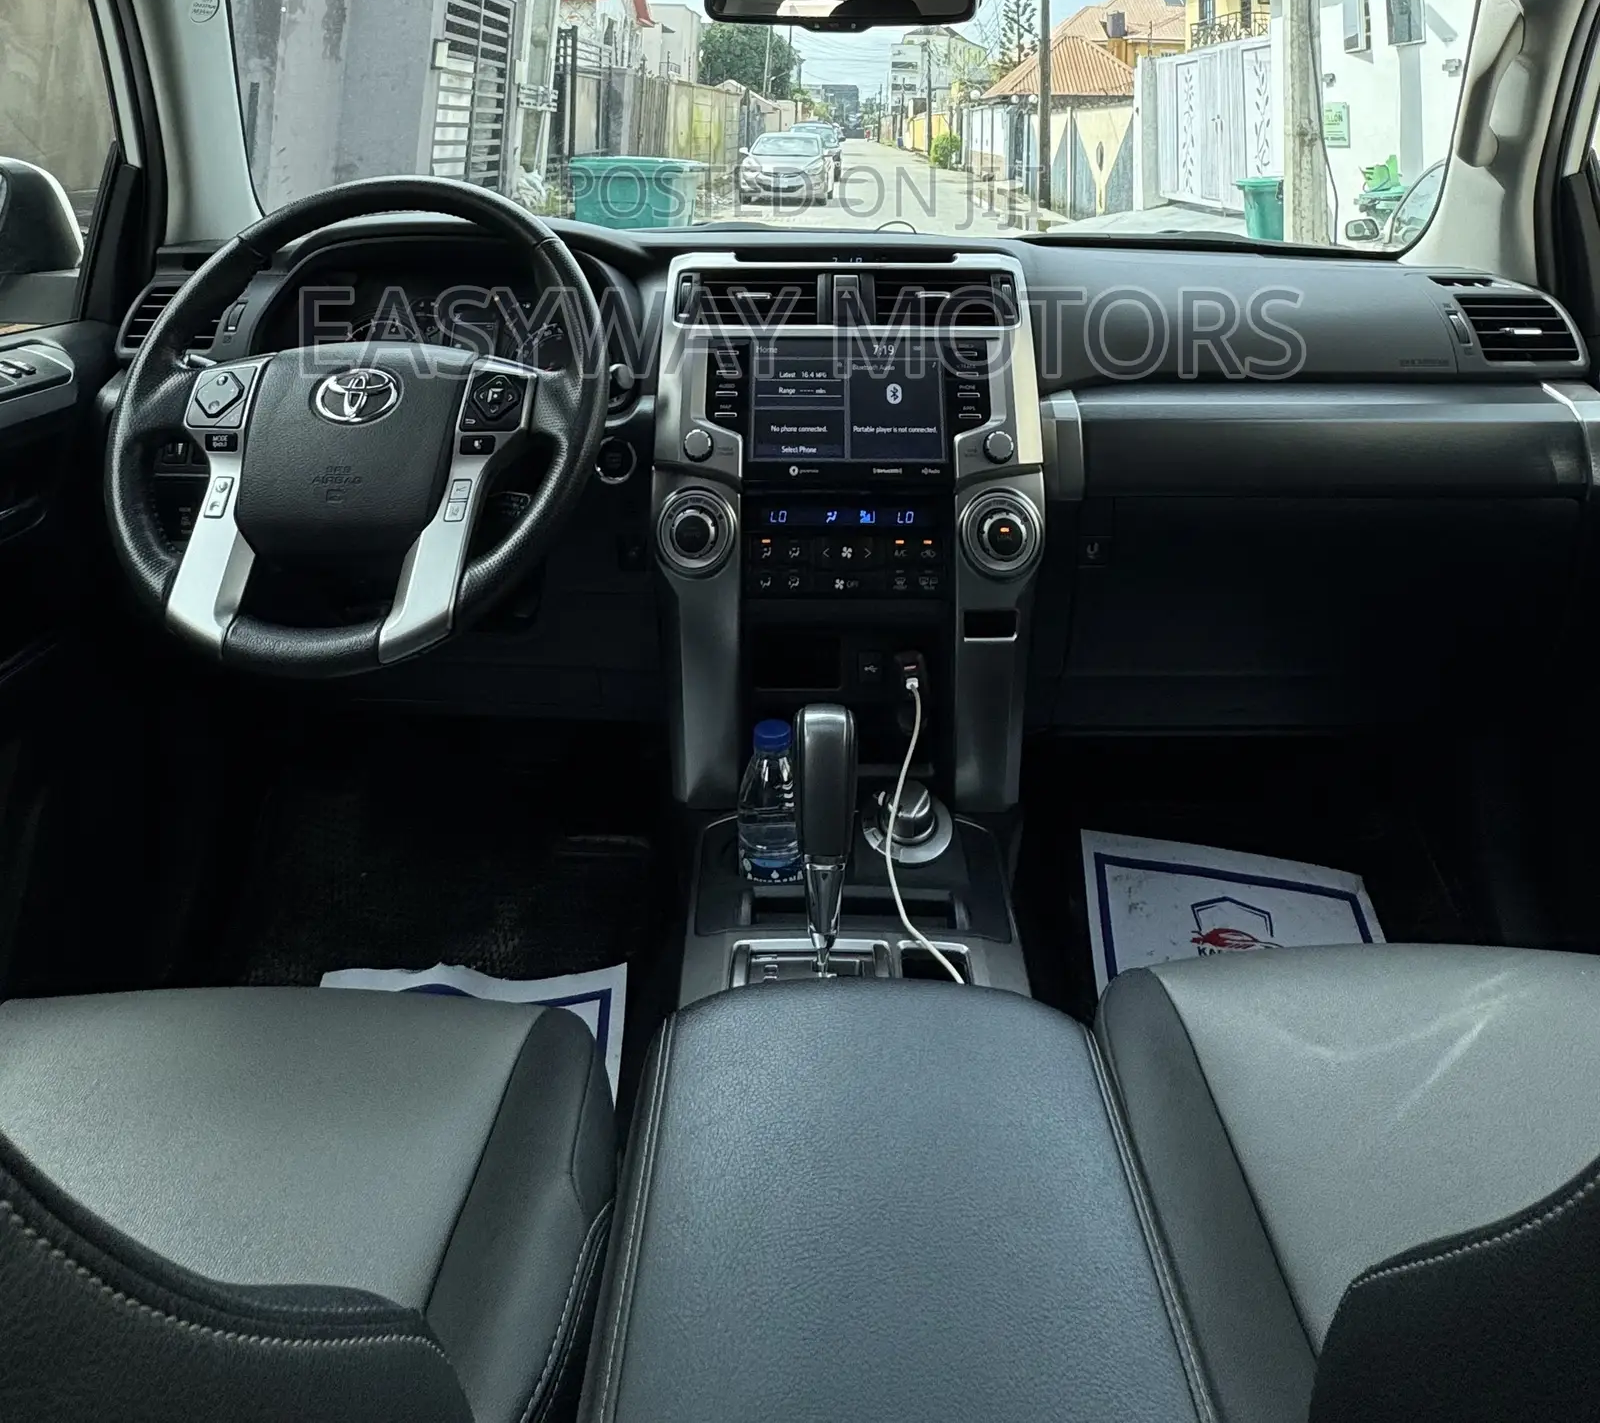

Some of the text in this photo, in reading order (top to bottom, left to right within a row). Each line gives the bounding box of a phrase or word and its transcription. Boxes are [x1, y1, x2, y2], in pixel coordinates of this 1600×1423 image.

[756, 345, 778, 354] Home
[873, 344, 895, 356] 7:19
[778, 386, 796, 395] Range
[770, 425, 780, 433] No
[780, 424, 797, 434] phone
[853, 425, 875, 433] Portable
[876, 425, 892, 434] player
[893, 425, 898, 433] is
[781, 445, 817, 454] Select Phone
[769, 510, 788, 523] LO
[896, 510, 915, 524] LO
[894, 549, 907, 557] A/C
[1197, 946, 1221, 956] KA
